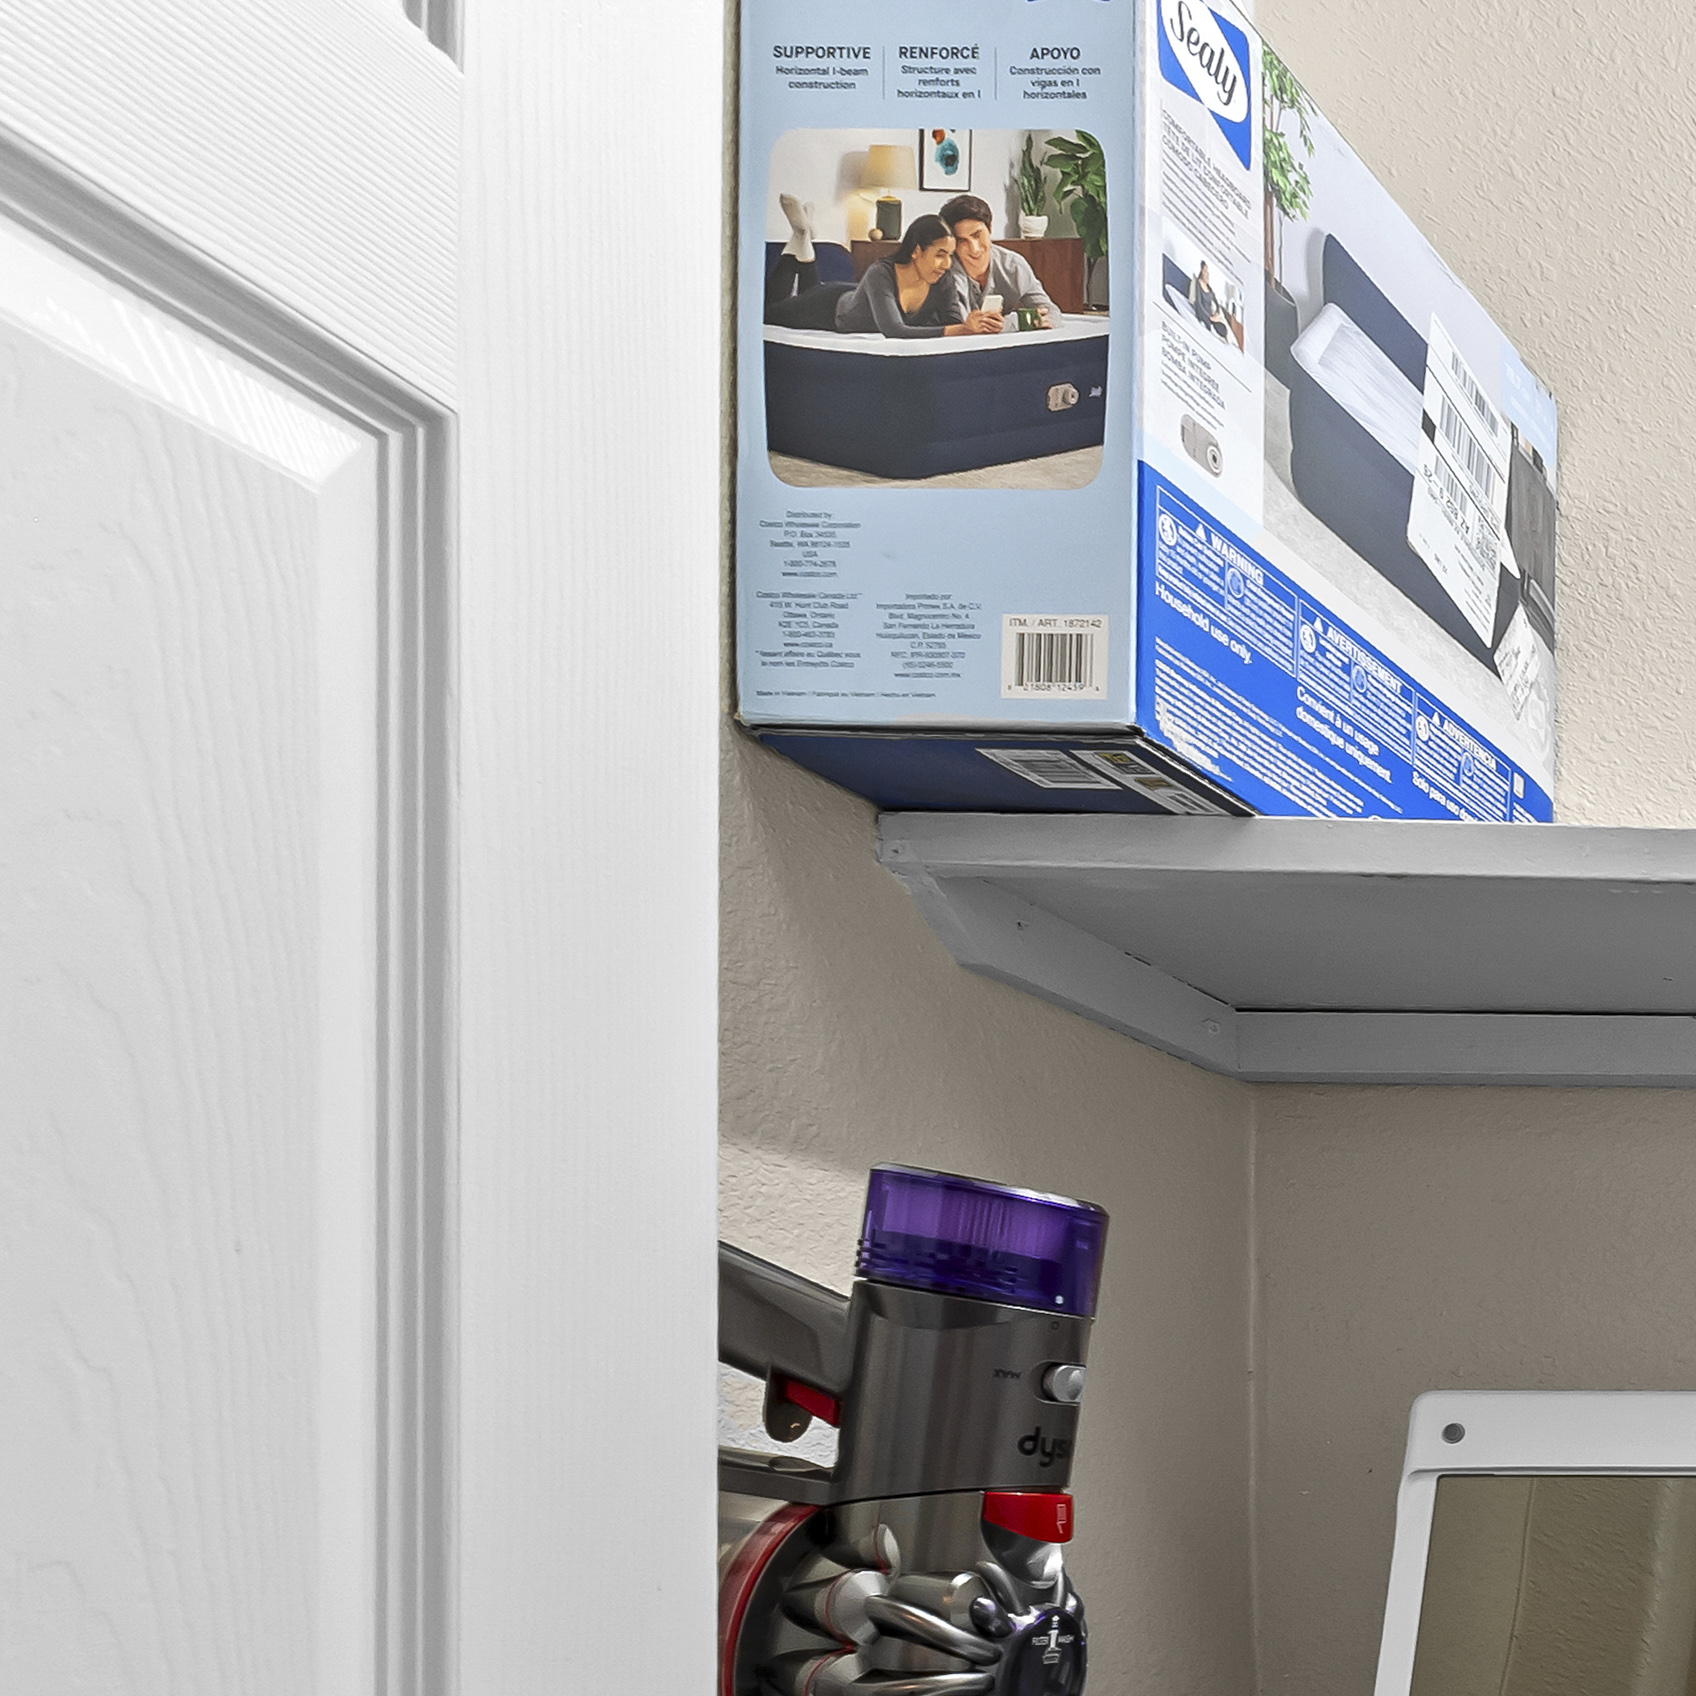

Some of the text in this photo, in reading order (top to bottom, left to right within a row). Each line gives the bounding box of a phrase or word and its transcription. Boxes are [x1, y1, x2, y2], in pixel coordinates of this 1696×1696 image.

[773, 45, 871, 60] SUPPORTIVE
[899, 43, 979, 60] RENFORCÉ
[1030, 47, 1081, 60] APOYO
[1170, 0, 1237, 106] Sealy
[776, 65, 830, 76] Horizontal
[901, 64, 976, 75] Structure avec
[1081, 67, 1101, 76] con
[788, 79, 856, 90] construction
[918, 77, 960, 88] renforts
[1058, 79, 1072, 88] en
[897, 89, 975, 99] horizontaux en
[1023, 89, 1087, 100] horizontales
[1210, 532, 1265, 586] WARNING
[1155, 581, 1210, 632] Household
[1211, 625, 1230, 647] use
[1063, 619, 1102, 629] 1872142
[1326, 626, 1402, 694] AVERTISSEMENT
[1296, 706, 1345, 750] domestique
[1443, 719, 1498, 771] ADVERTENCIA
